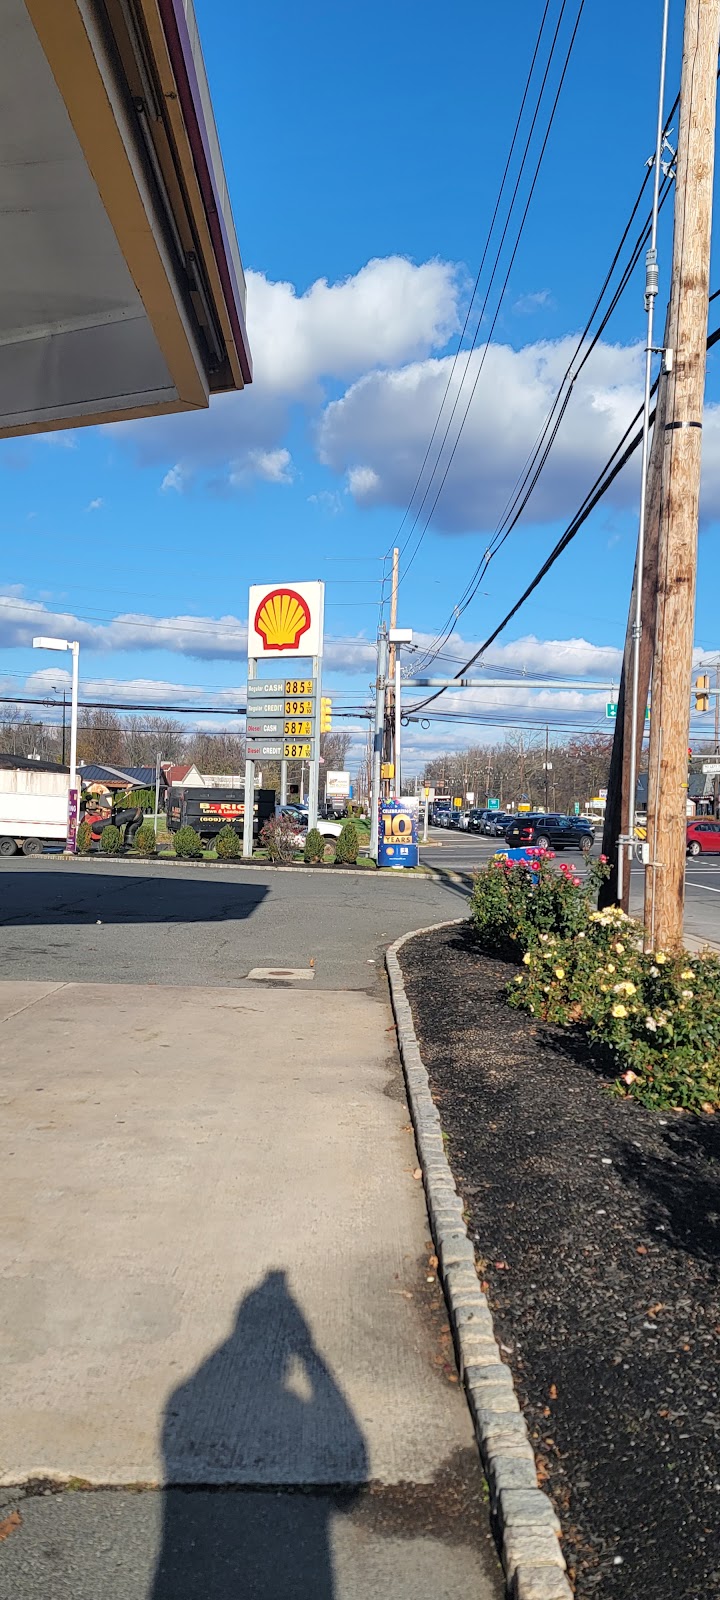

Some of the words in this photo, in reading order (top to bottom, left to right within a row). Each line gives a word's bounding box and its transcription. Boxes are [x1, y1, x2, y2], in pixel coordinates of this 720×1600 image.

[264, 684, 283, 692] CASH
[286, 681, 305, 693] 385
[286, 702, 304, 713] 395
[284, 722, 302, 733] 587
[284, 745, 303, 756] 587
[382, 813, 412, 836] 10
